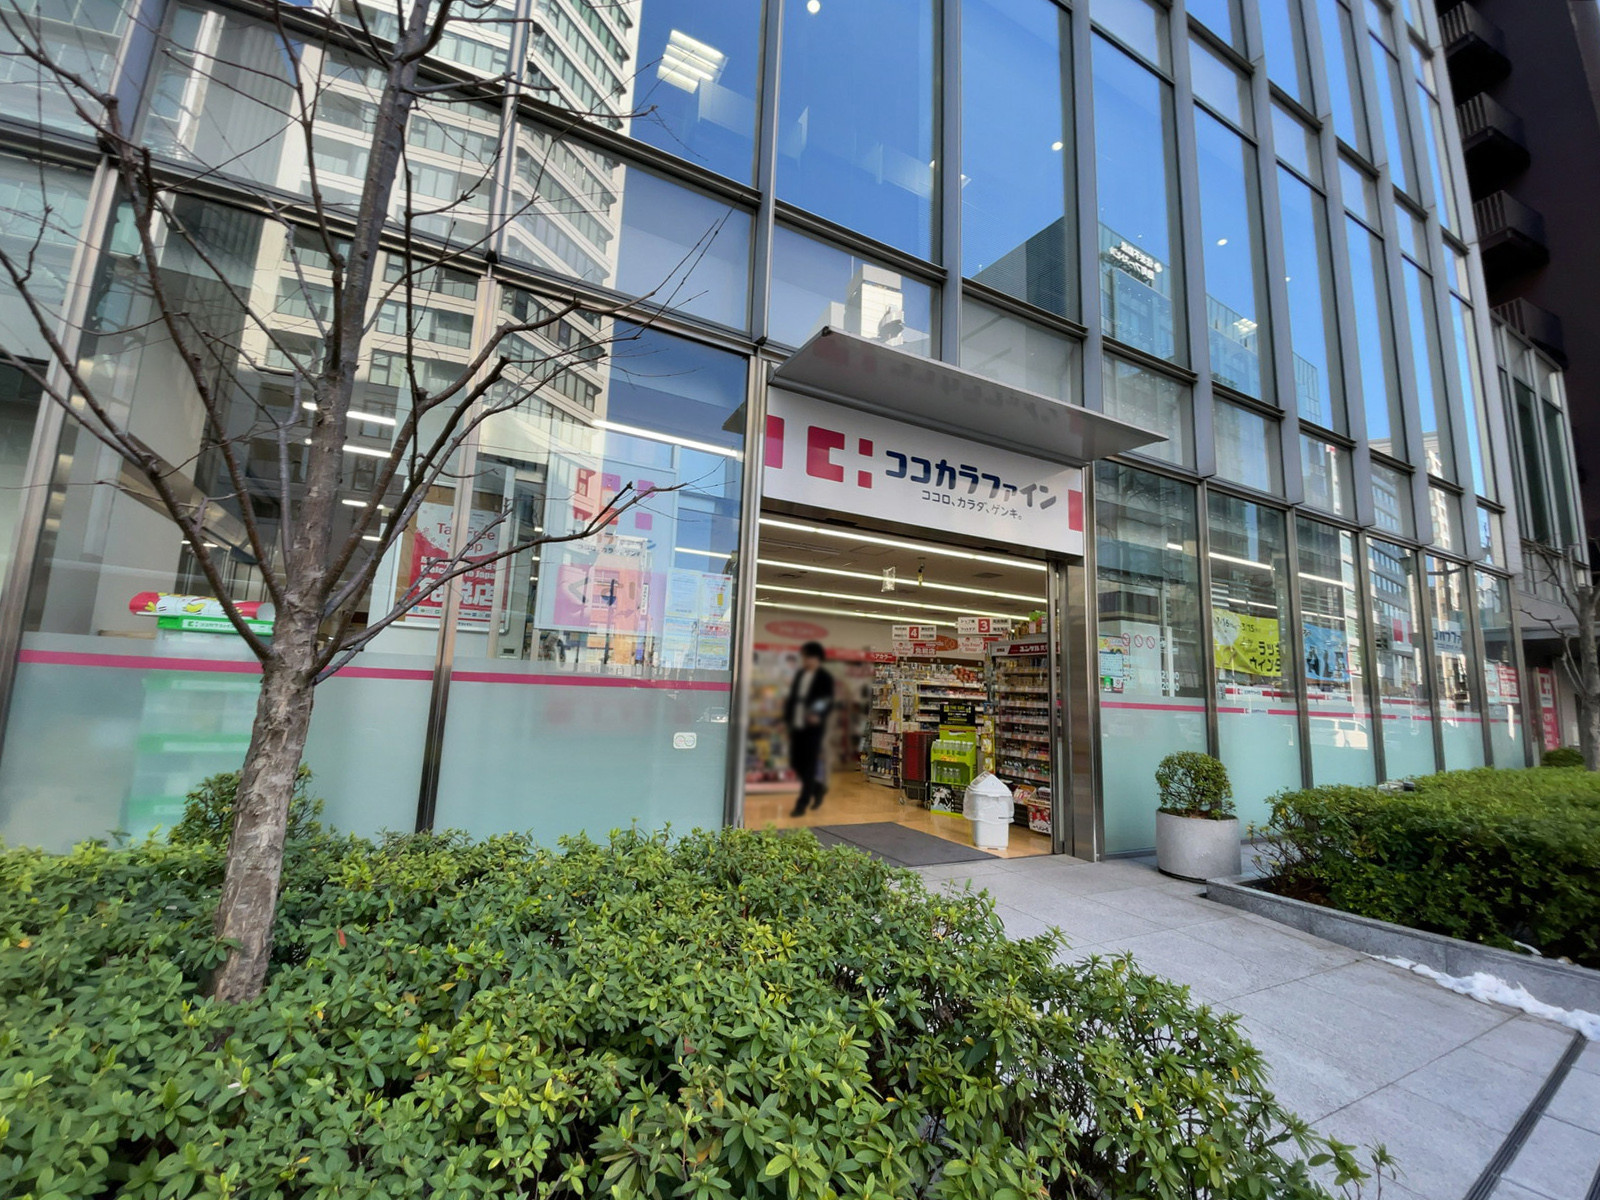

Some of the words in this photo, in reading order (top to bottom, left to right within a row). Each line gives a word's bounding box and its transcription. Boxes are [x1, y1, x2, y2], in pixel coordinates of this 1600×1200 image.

[885, 450, 1057, 511] ココカラファイン
[921, 490, 1023, 521] ココロ、カラダ、ゲンキ。
[910, 628, 917, 638] 4
[980, 620, 989, 632] 3
